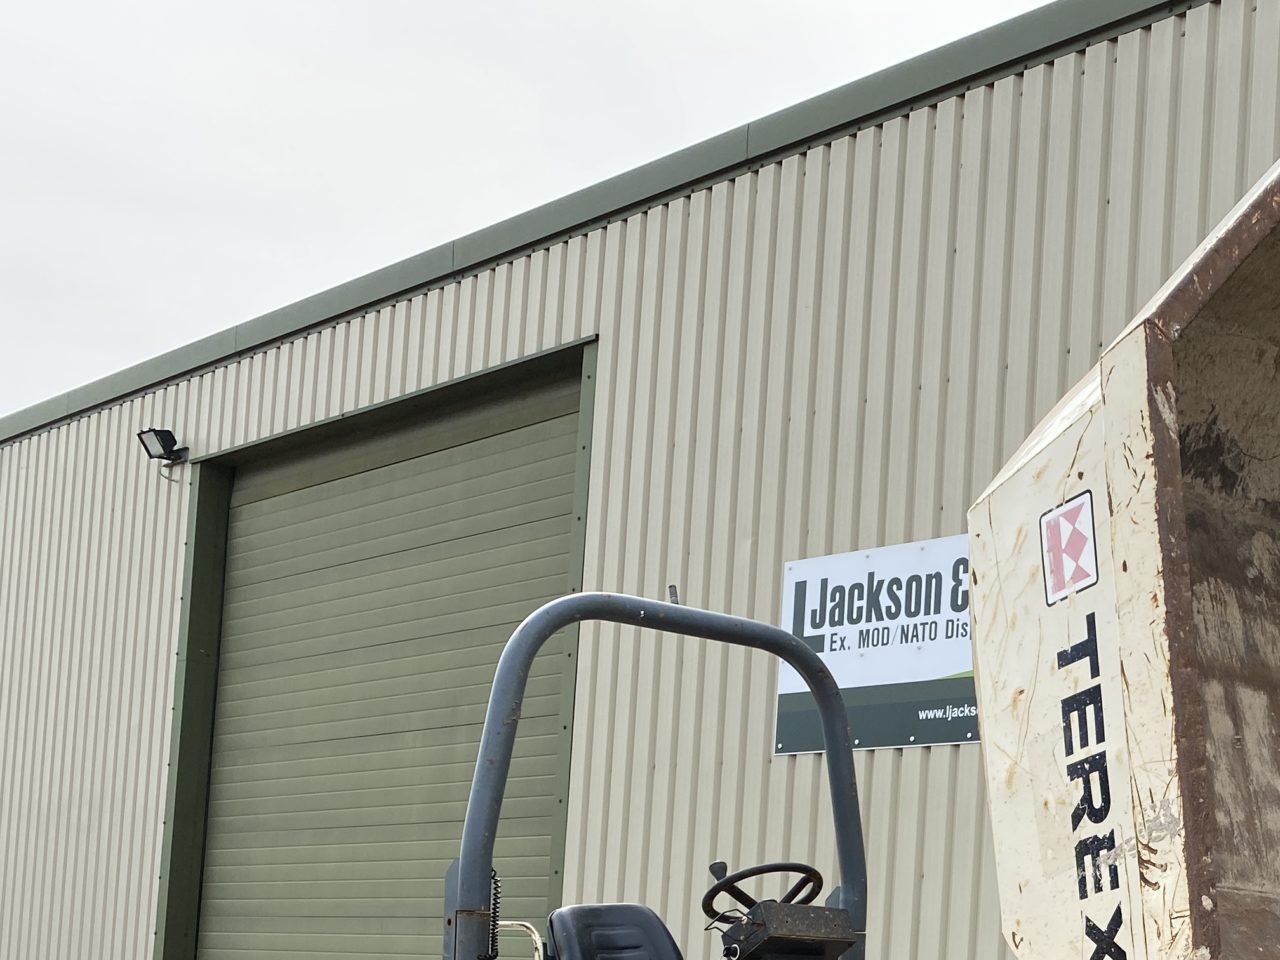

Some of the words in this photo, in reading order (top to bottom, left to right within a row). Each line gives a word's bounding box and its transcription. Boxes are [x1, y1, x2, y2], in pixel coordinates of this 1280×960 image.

[829, 633, 851, 652] Ex.
[858, 621, 938, 649] MOD/NATO
[945, 618, 972, 640] Dis
[918, 704, 978, 721] www.ljacks
